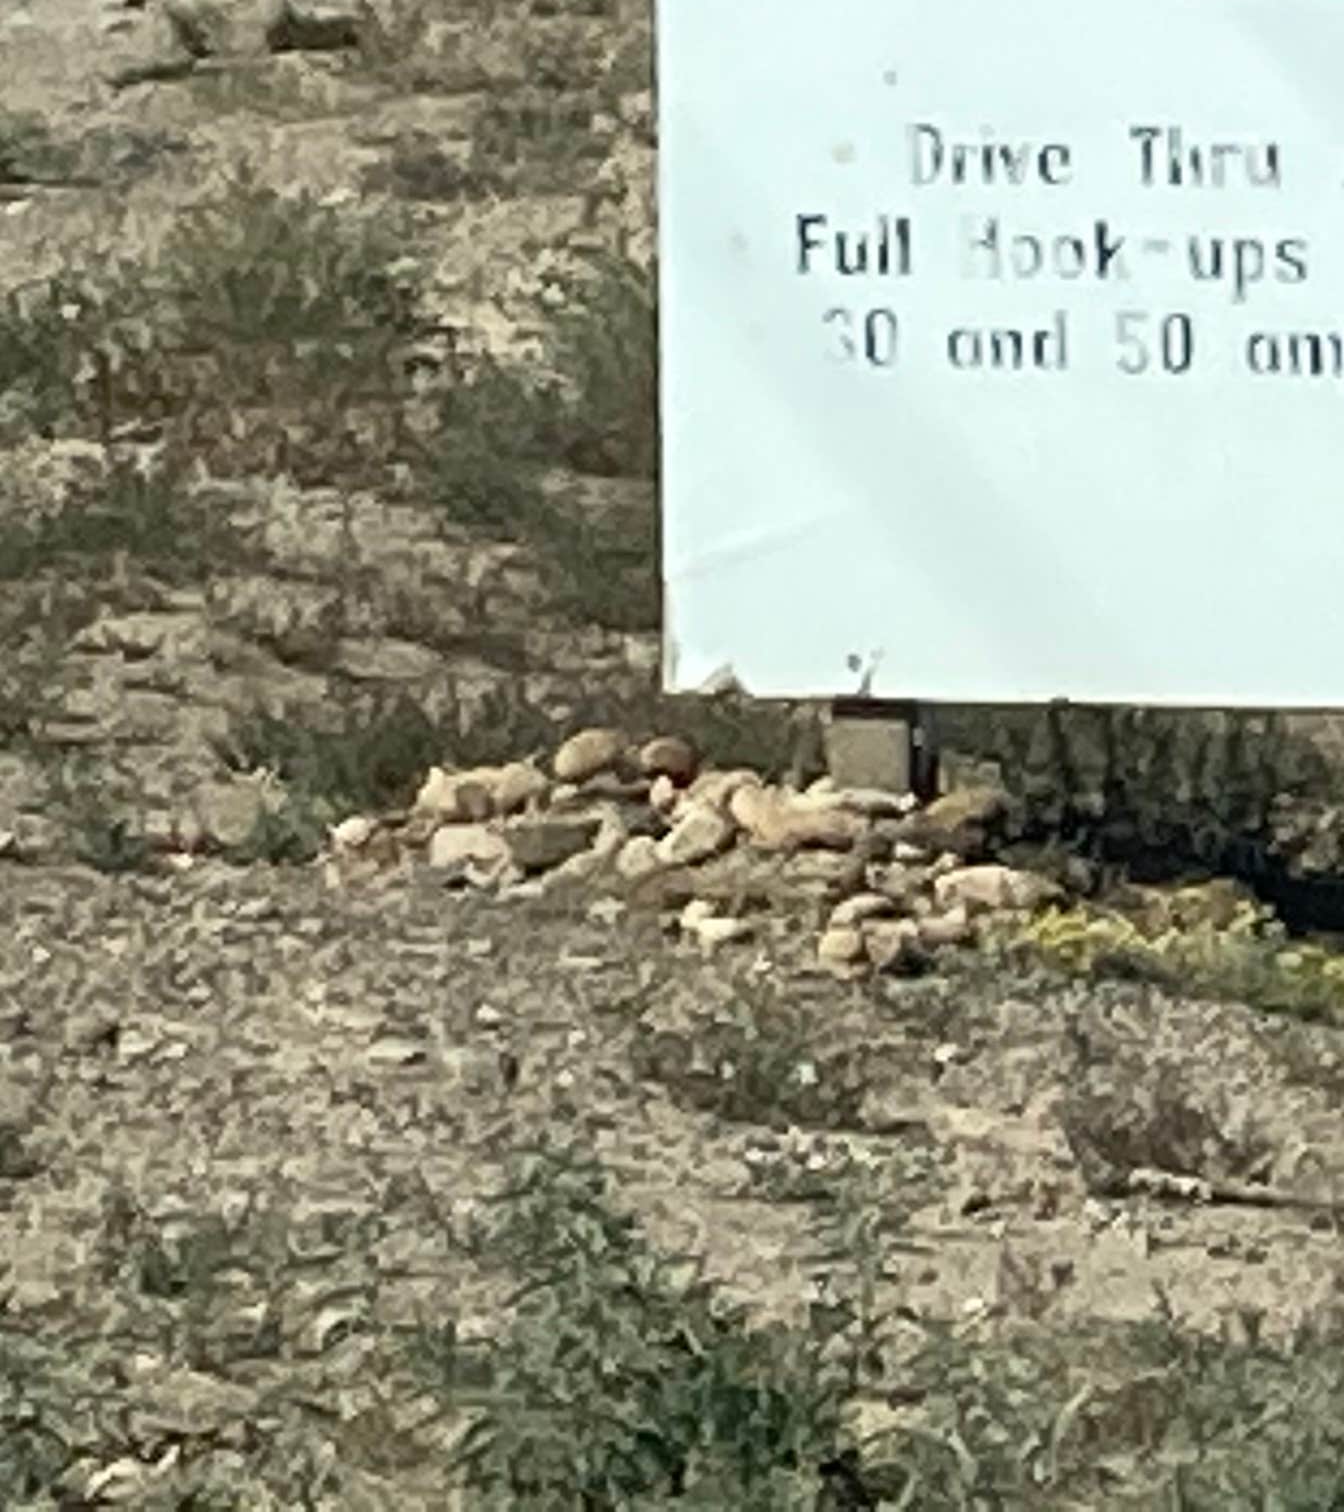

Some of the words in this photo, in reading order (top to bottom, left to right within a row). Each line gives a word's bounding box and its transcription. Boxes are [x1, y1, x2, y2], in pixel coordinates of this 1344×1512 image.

[908, 121, 1074, 188] Drive
[1128, 124, 1281, 188] Thru
[795, 212, 912, 276] Full
[946, 308, 1070, 372] and
[1115, 310, 1195, 376] 50
